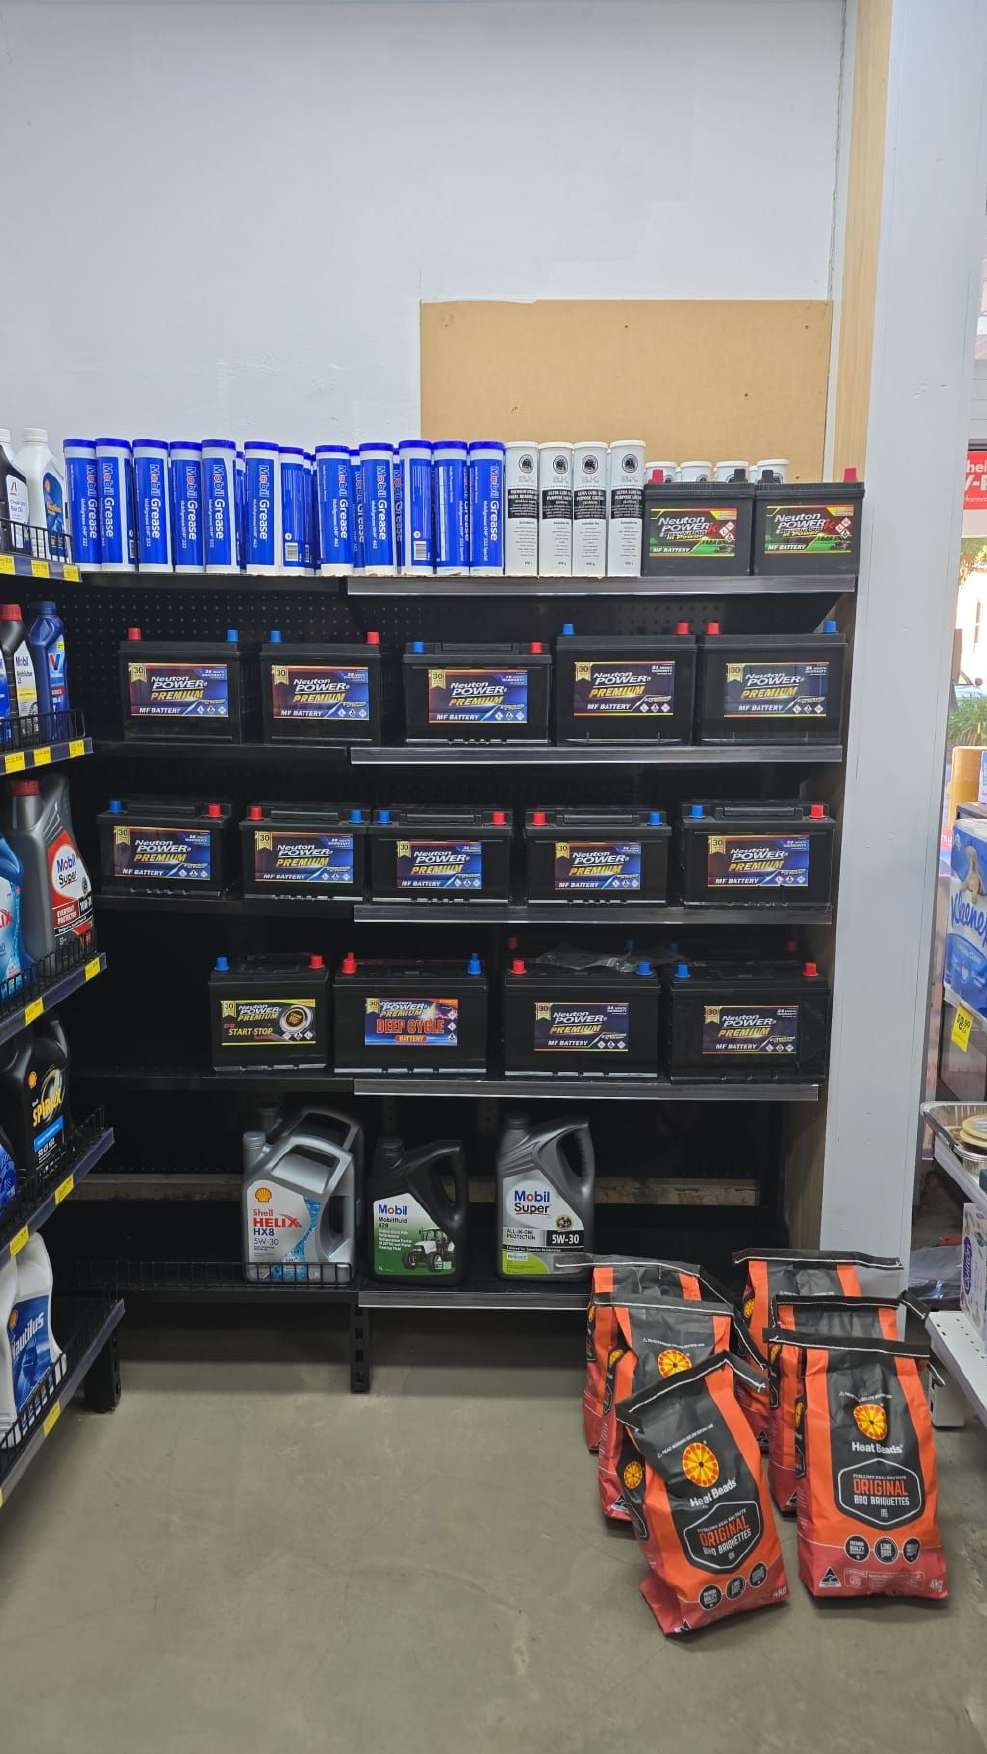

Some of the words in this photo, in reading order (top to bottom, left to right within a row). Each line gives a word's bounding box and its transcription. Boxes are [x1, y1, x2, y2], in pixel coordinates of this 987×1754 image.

[103, 463, 114, 496] Mobil
[150, 464, 160, 497] Mobil
[186, 467, 198, 498] Mobil
[213, 465, 224, 497] Mobil
[259, 465, 270, 498] Mobil
[338, 465, 348, 497] Mobil
[377, 466, 386, 498] Mobil
[490, 466, 500, 499] Mobil
[88, 499, 98, 539] Grease
[105, 498, 114, 538] Grease
[152, 499, 160, 539] Grease
[188, 500, 198, 540] Grease
[215, 499, 225, 540] Grease
[260, 500, 270, 540] Grease
[340, 499, 348, 538] Grease
[378, 500, 388, 540] Grease
[491, 500, 500, 541] Grease
[658, 517, 704, 525] Neuton
[775, 513, 821, 522] Neuton
[660, 523, 709, 534] POWER
[777, 520, 825, 531] POWER
[153, 680, 204, 689] POWER
[595, 676, 647, 685] POWER
[747, 677, 800, 686] POWER
[296, 683, 346, 691] POWER
[452, 686, 504, 695] POWER
[589, 686, 645, 698] PREMIUM
[742, 687, 798, 698] PREMIUM
[151, 690, 203, 700] PREMIUM
[293, 693, 346, 702] PREMIUM
[449, 696, 503, 706] PREMIUM
[134, 853, 187, 862] PREMIUM
[416, 855, 466, 863] POWER
[574, 855, 626, 864] POWER
[732, 851, 785, 860] POWER
[57, 855, 76, 873] Mobil
[276, 858, 328, 867] PREMIUM
[729, 861, 784, 871] PREMIUM
[411, 865, 463, 874] PREMIUM
[569, 865, 622, 876] PREMIUM
[59, 871, 77, 885] Super
[237, 1013, 279, 1021] PREMIUM
[555, 1015, 603, 1023] POWER
[724, 1018, 773, 1027] POWER
[377, 1019, 405, 1033] DEEP
[407, 1019, 444, 1033] CYCLE
[550, 1025, 602, 1033] PREMIUM
[719, 1028, 770, 1037] PREMIUM
[514, 1191, 550, 1202] Mobil
[379, 1204, 407, 1215] Mobil
[514, 1203, 549, 1214] Super
[253, 1218, 302, 1228] HELIX
[253, 1228, 275, 1236] HX8
[552, 1235, 579, 1244] 5W-30
[852, 1441, 874, 1452] Heat
[876, 1444, 902, 1454] Beads
[854, 1479, 909, 1495] ORIGINAL
[690, 1492, 712, 1507] Heat
[711, 1479, 736, 1499] Beads
[870, 1496, 910, 1505] BRIQUETTES
[700, 1515, 749, 1546] ORIGINAL
[718, 1528, 752, 1553] BRIQUETTES
